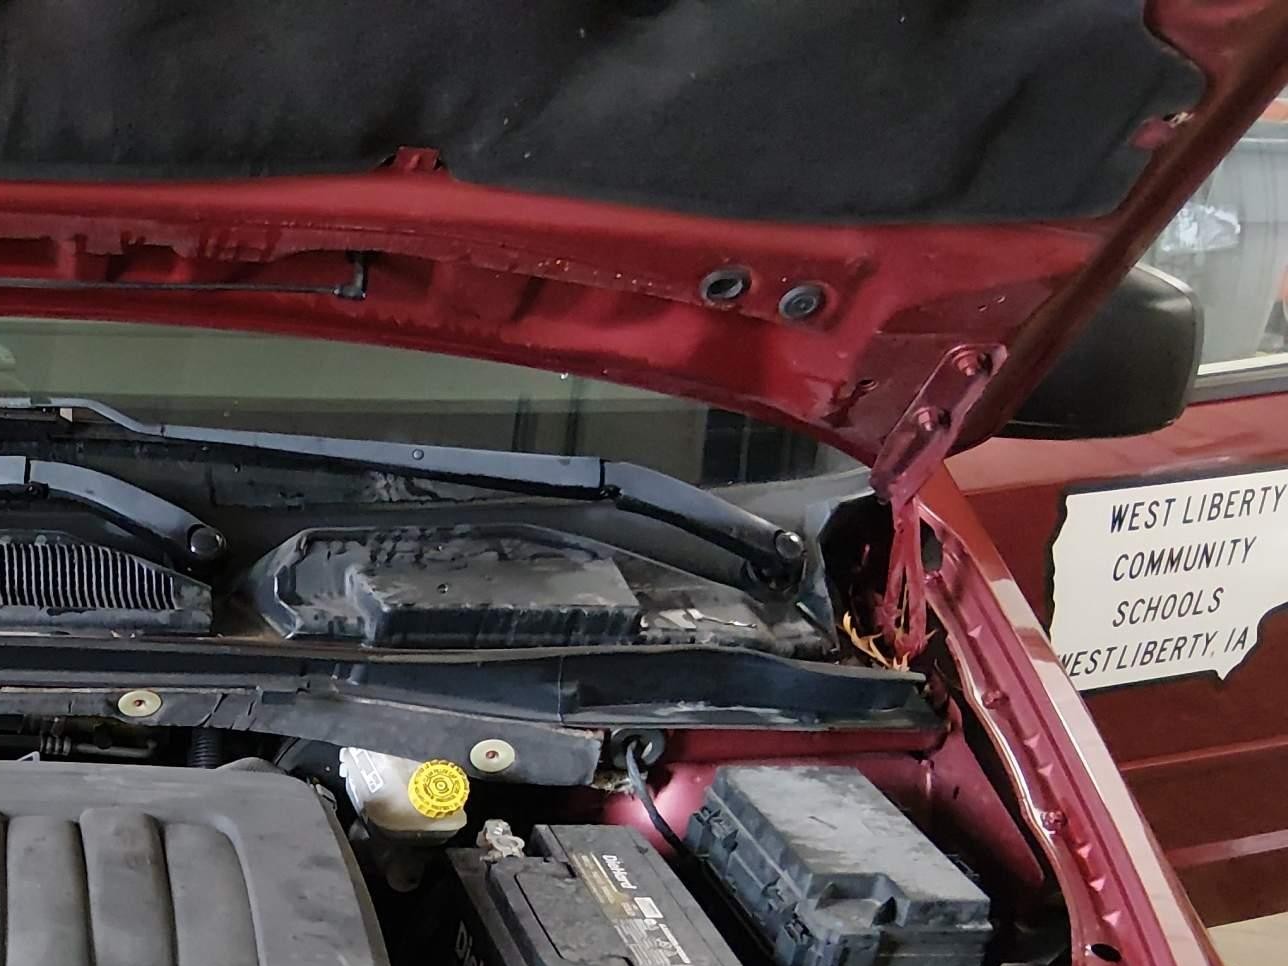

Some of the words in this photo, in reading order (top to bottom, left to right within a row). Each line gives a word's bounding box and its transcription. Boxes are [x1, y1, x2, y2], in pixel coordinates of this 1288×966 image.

[1110, 498, 1177, 534] WEST
[1182, 484, 1288, 525] LIBERTY
[1112, 535, 1257, 582] COMMUNITY
[1112, 586, 1225, 628] SCHOOLS
[1223, 626, 1250, 654] IA
[602, 854, 638, 890] DieHard
